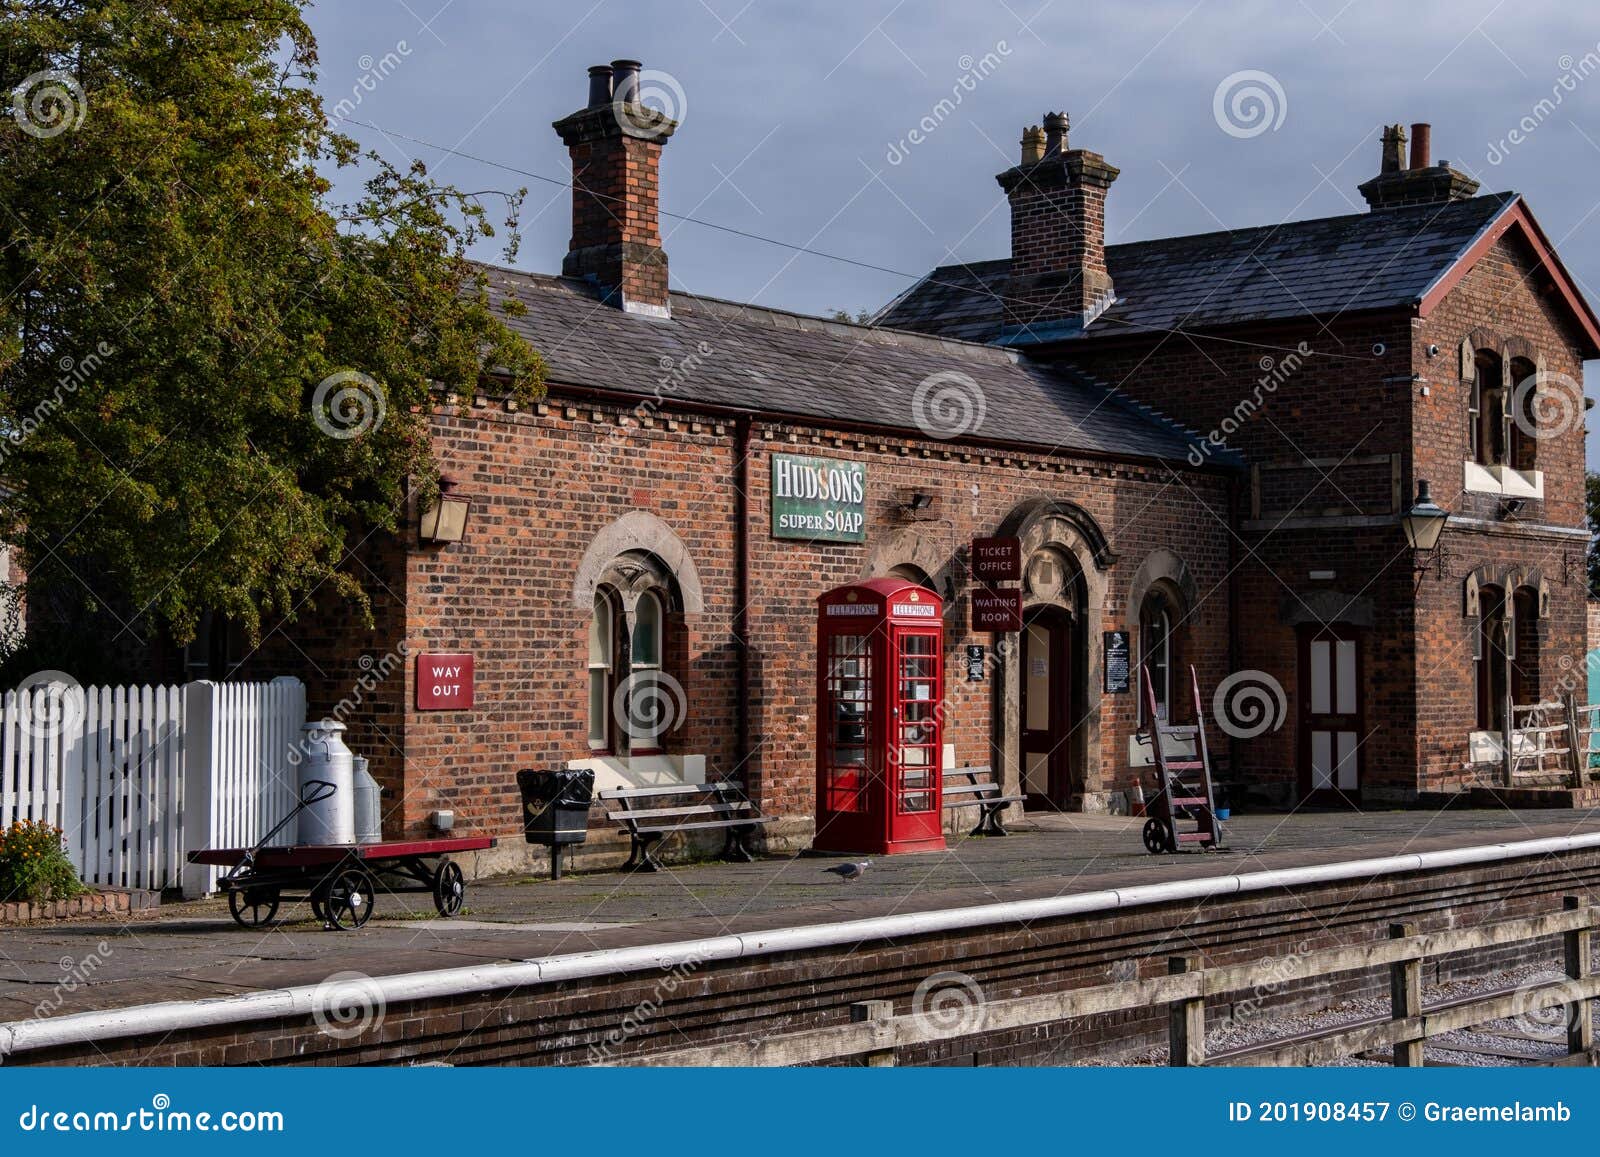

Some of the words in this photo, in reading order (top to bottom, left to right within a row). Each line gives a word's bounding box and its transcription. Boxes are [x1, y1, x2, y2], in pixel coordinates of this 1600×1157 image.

[780, 514, 823, 530] SUPER
[825, 510, 863, 533] SOAP
[979, 546, 1013, 557] TICKET
[979, 561, 1013, 571] OFFICE
[975, 598, 1017, 608] WAITING
[894, 605, 935, 616] TELEPHONE
[981, 613, 1011, 622] ROOM
[432, 667, 460, 678] WAY
[432, 685, 460, 696] OUT
